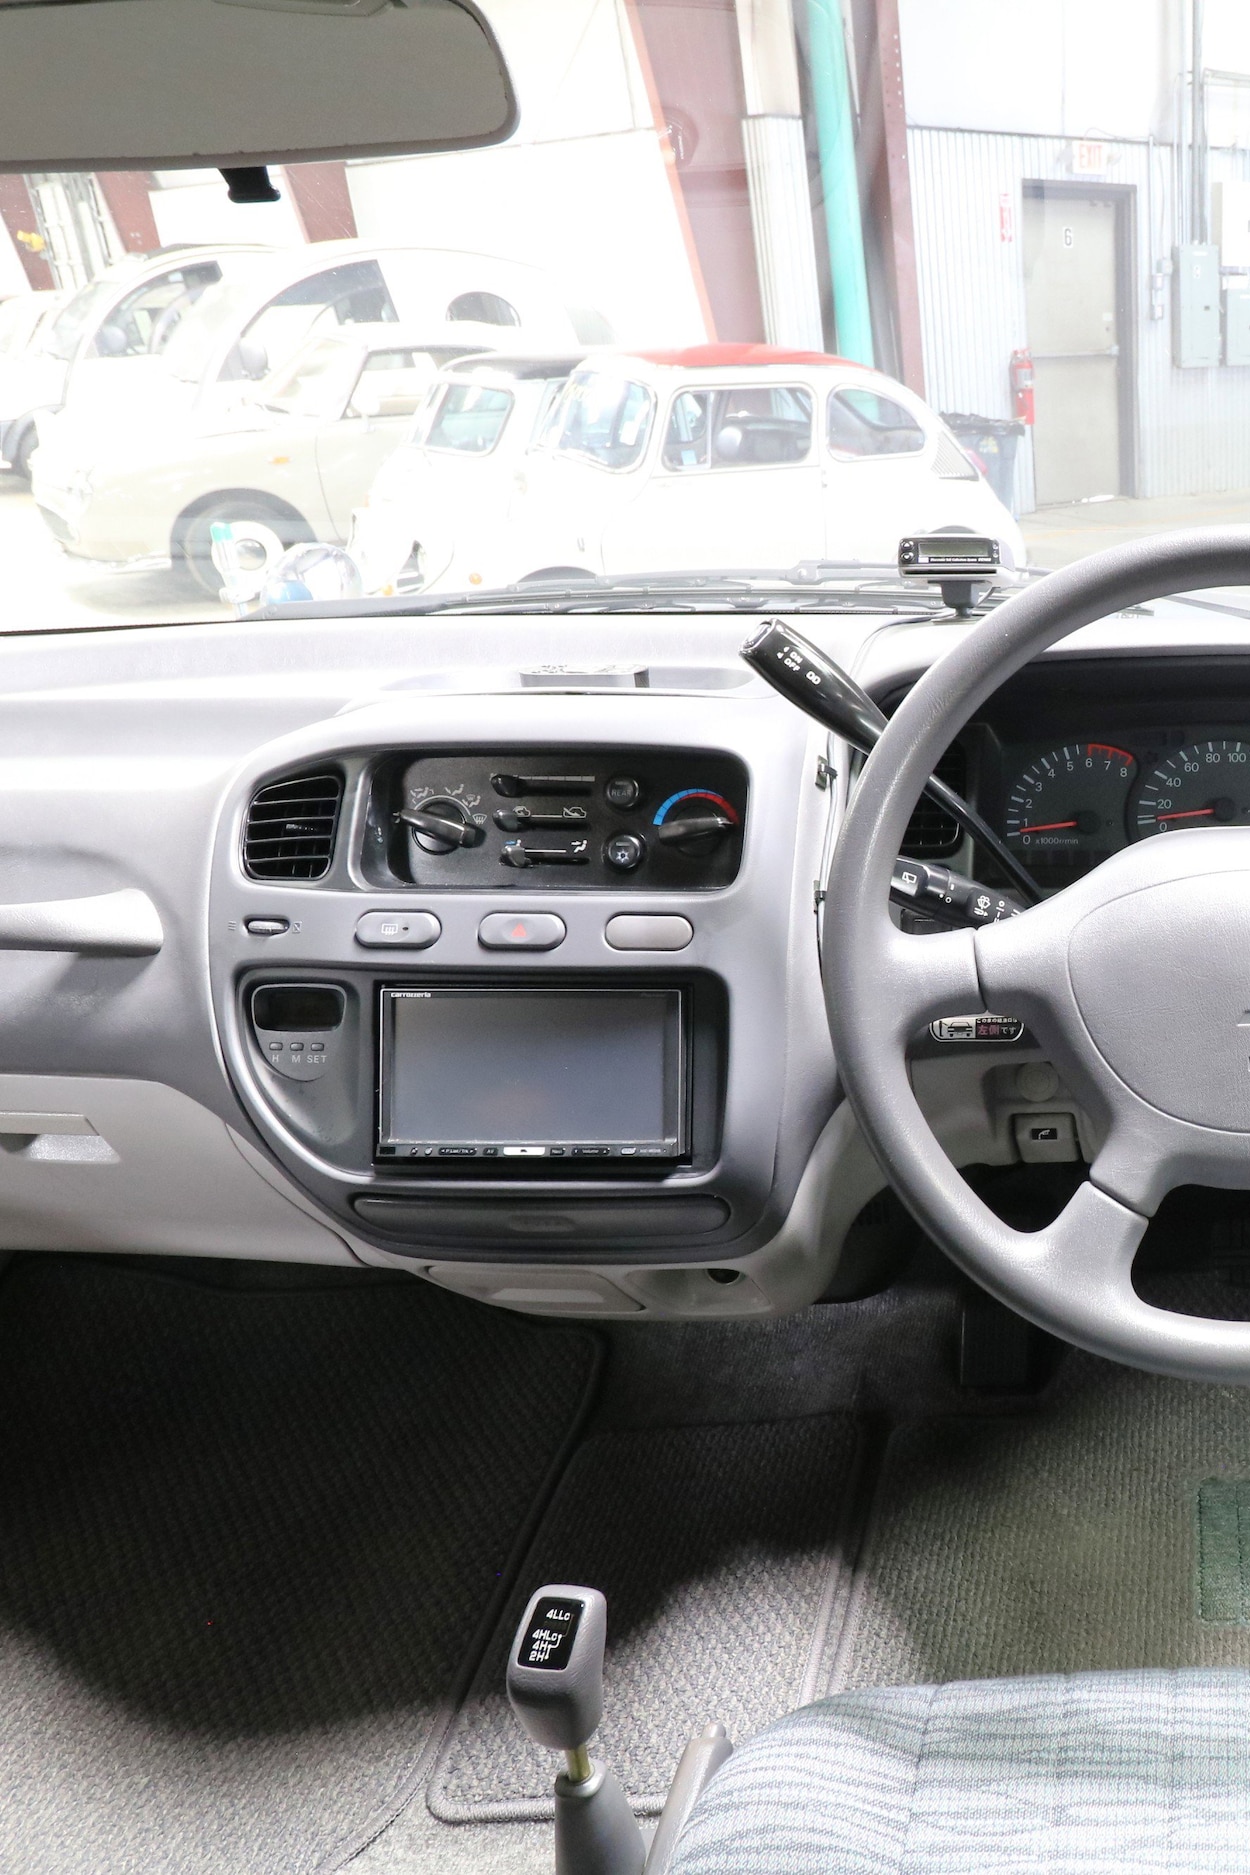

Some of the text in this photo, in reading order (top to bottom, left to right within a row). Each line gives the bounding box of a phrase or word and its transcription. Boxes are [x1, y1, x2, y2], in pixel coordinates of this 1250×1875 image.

[1078, 143, 1103, 169] EXIT
[1064, 228, 1072, 246] 6
[790, 651, 803, 664] ON
[784, 658, 800, 671] OFF
[806, 671, 821, 685] OD
[1085, 757, 1093, 768] 6
[1205, 752, 1221, 763] 80
[1227, 752, 1247, 763] 100
[1066, 761, 1074, 771] 5
[1104, 760, 1111, 771] 7
[1184, 762, 1200, 773] 60
[1048, 768, 1056, 778] 4
[1119, 767, 1128, 777] 8
[1035, 782, 1043, 792] 3
[1165, 777, 1182, 788] 40
[1025, 799, 1033, 808] 2
[1157, 799, 1172, 809] 20
[1023, 818, 1028, 827] 1
[1159, 822, 1168, 832] 0
[1022, 835, 1031, 845] 0
[978, 1024, 1016, 1035] 左側です
[272, 1054, 328, 1064] H M SET
[532, 1640, 548, 1651] 4H
[528, 1651, 545, 1662] 2H
